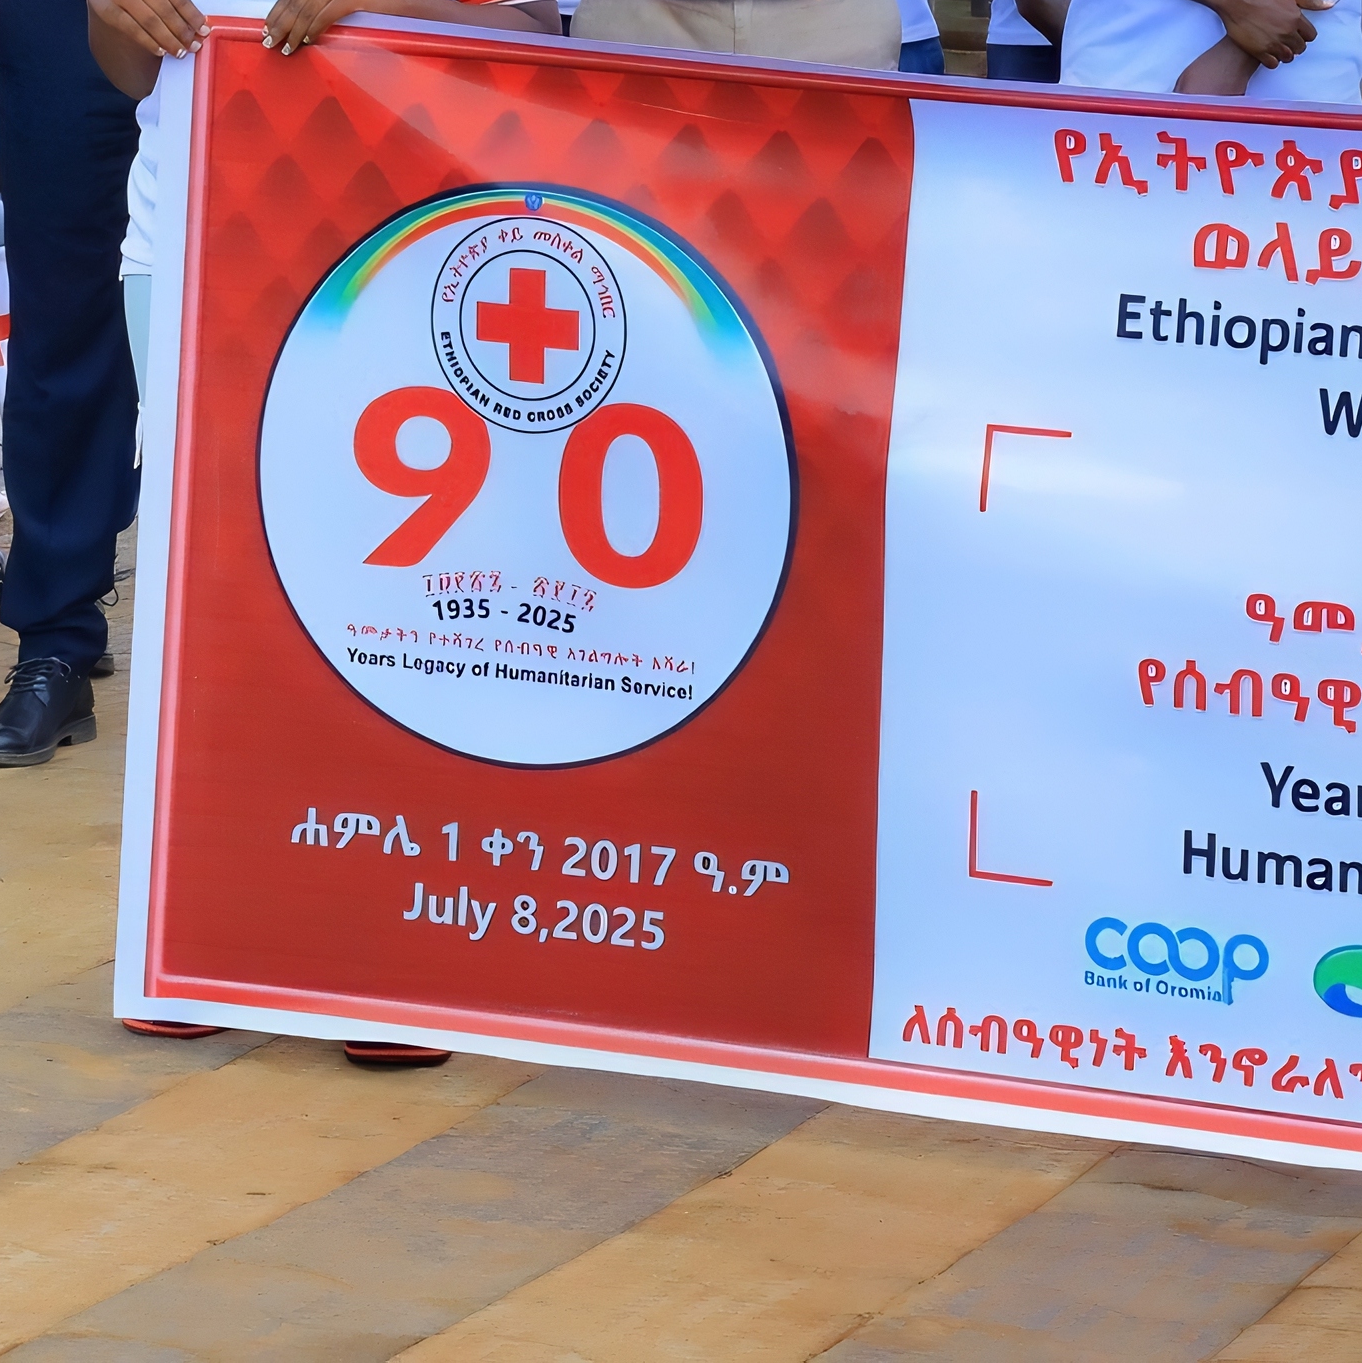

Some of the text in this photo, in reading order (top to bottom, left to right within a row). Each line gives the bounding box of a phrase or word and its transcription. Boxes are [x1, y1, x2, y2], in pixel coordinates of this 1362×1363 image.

[441, 331, 615, 423] ETHIOPIAN RED CROSS SOCIETY
[432, 598, 490, 621] 1935
[517, 603, 577, 633] 2025
[472, 662, 490, 677] of
[495, 663, 615, 691] Humanitarian
[1138, 658, 1362, 734] የሰብዓዊ
[291, 807, 790, 897] ሐምሌ 1 ቀን 2017 ዓ.ም
[403, 882, 666, 950] July 8,2025
[1084, 971, 1222, 1002] Bank of Oromia
[903, 1004, 1147, 1071] ለሰብዓዊነት
